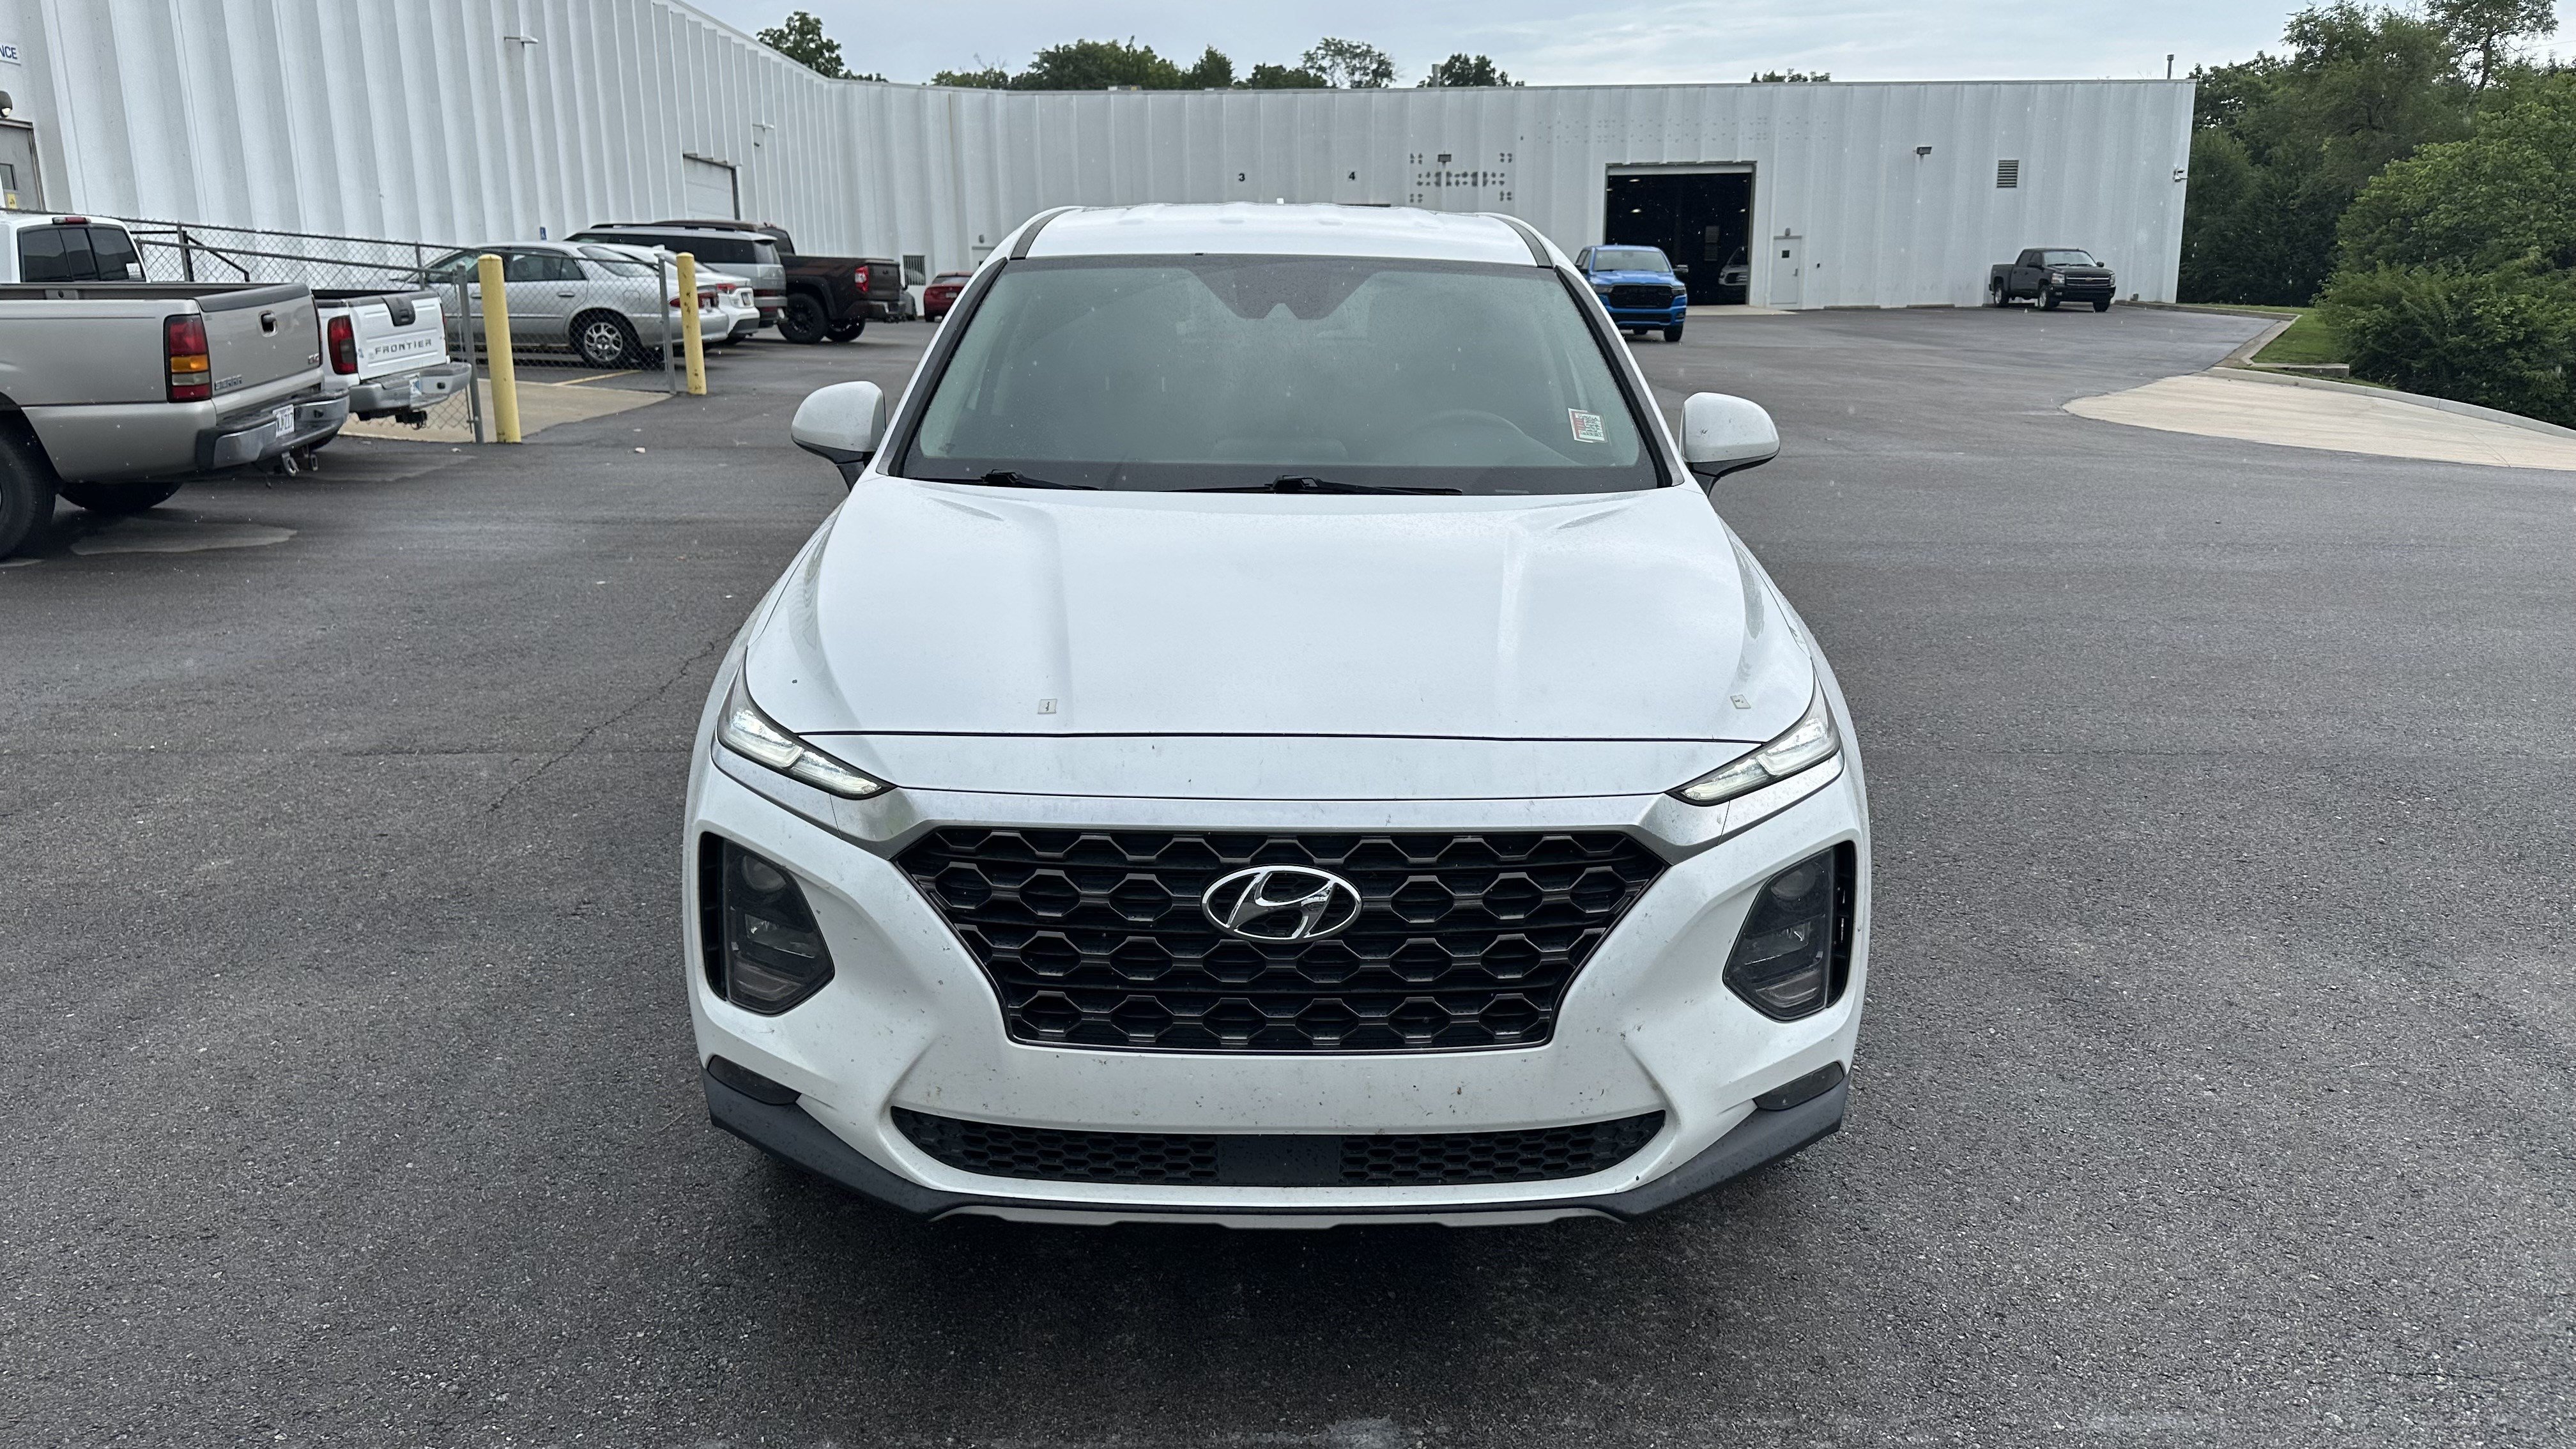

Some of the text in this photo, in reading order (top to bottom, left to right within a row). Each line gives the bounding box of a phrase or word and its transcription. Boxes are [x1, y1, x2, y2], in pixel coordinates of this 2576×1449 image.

[0, 45, 17, 59] NCE
[1238, 172, 1245, 182] 3
[1348, 171, 1355, 181] 4
[375, 338, 431, 355] FRONTIER
